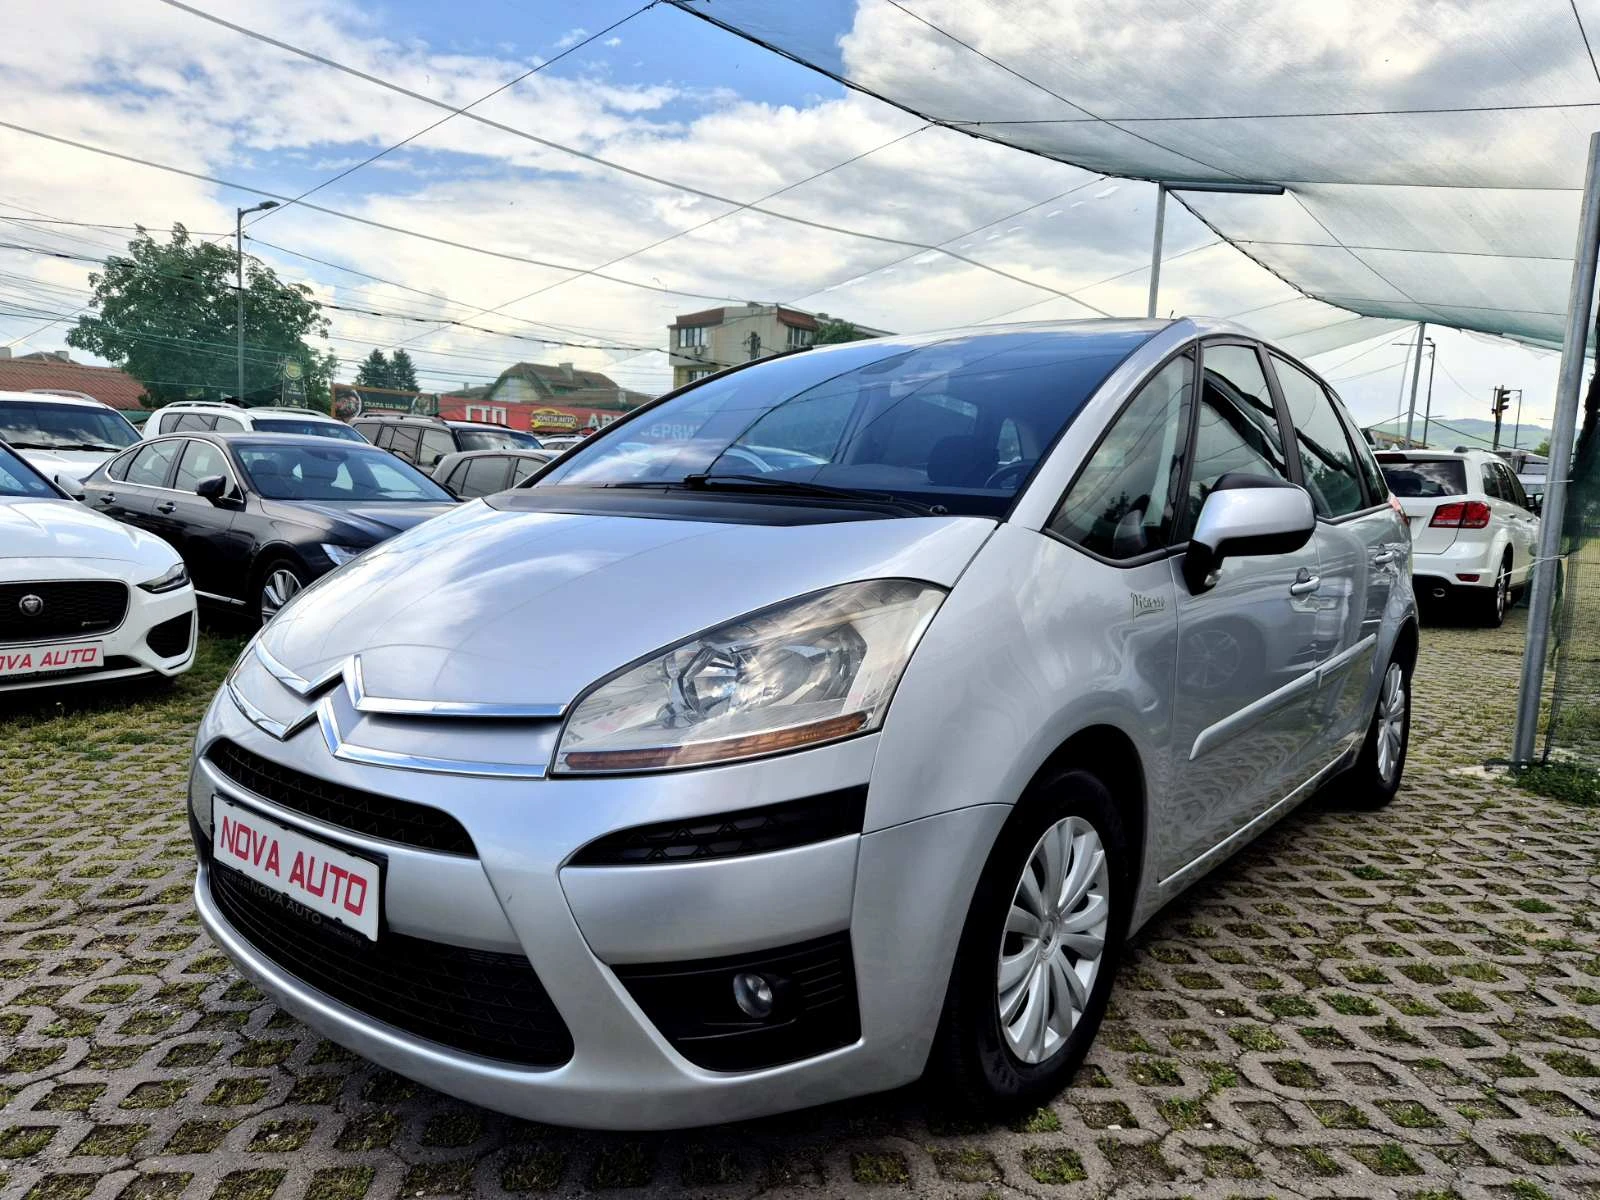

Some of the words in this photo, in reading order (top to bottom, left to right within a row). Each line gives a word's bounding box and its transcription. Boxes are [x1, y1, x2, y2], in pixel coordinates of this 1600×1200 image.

[466, 405, 507, 425] ГТП
[40, 647, 97, 667] AUTO
[220, 815, 280, 880] NOVA
[288, 851, 368, 917] AUTO
[250, 880, 284, 908] NOVA
[286, 901, 322, 925] AUTO
